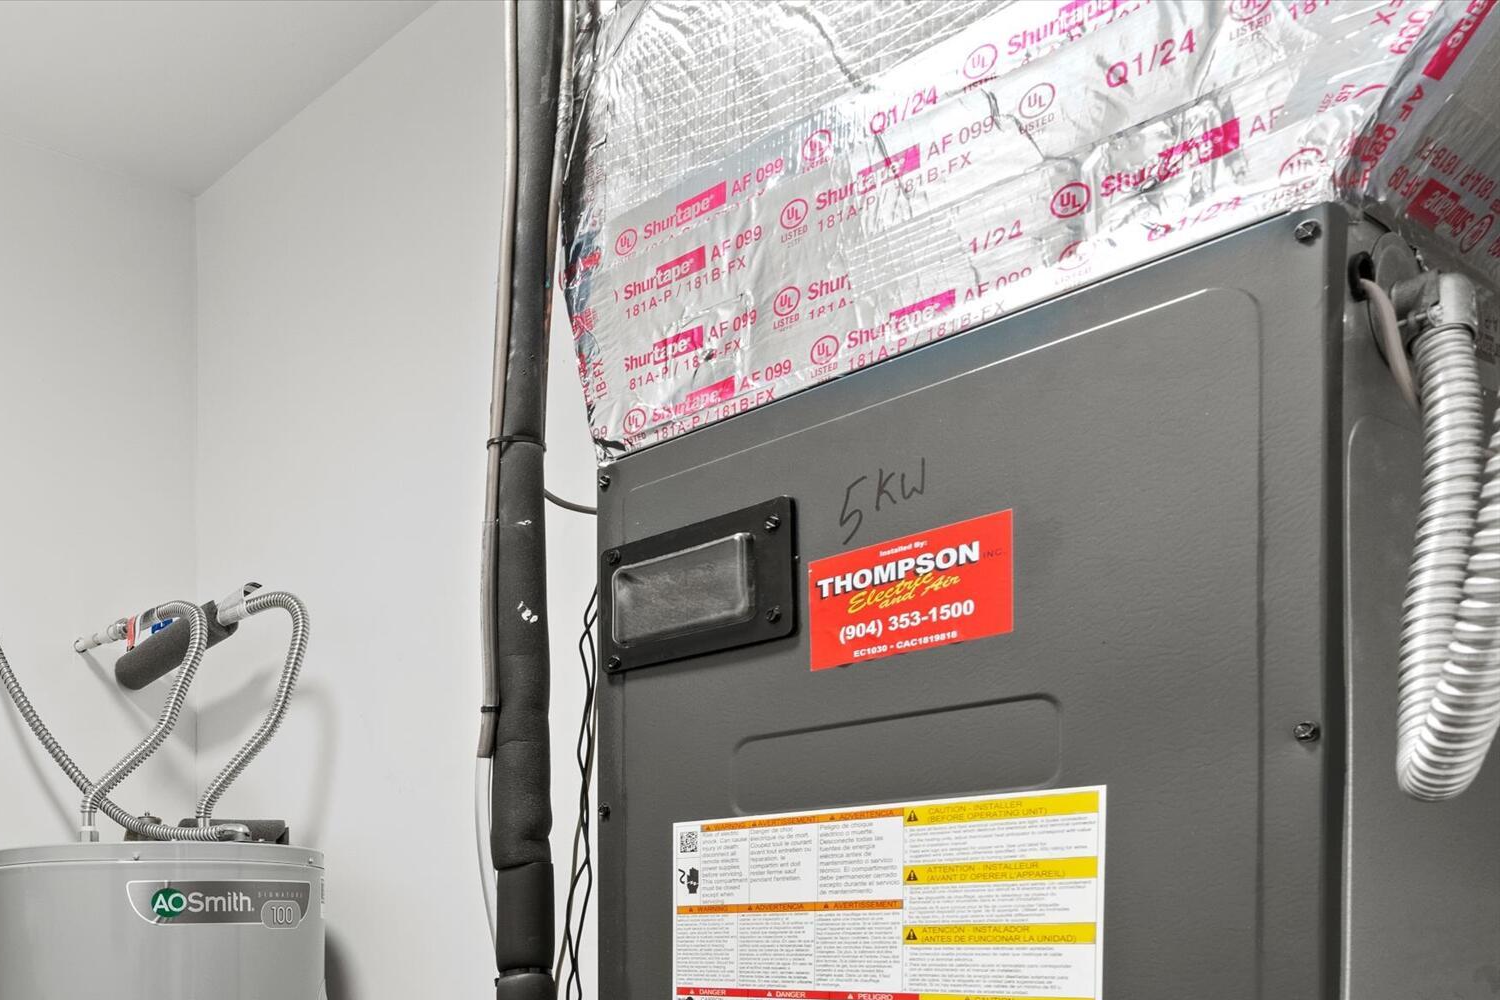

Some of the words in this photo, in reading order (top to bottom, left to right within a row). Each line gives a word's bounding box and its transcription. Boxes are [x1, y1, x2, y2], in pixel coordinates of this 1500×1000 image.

[1106, 29, 1197, 88] Q1/24
[869, 86, 938, 135] Q1/24
[1249, 105, 1285, 137] AF
[926, 134, 954, 161] AF
[959, 115, 995, 143] 099
[643, 192, 716, 240] Shurtape
[731, 171, 754, 196] AF
[756, 157, 784, 183] 099
[1059, 192, 1081, 211] UL
[780, 225, 808, 243] LISTED
[624, 258, 695, 301] Shurtape
[711, 238, 731, 262] AF
[735, 224, 763, 250] 099
[626, 289, 673, 319] 181A-P
[686, 256, 748, 295] 181B-FX
[732, 309, 758, 334] 099
[773, 313, 800, 330] LISTED
[849, 336, 909, 371] 181A-P
[764, 359, 793, 382] 099
[809, 361, 838, 379] LISTED
[839, 475, 868, 546] 5
[875, 457, 926, 512] KW
[878, 543, 912, 558] Installed
[914, 539, 928, 552] By:
[816, 540, 981, 599] THOMPSON
[846, 572, 934, 615] Electric
[879, 592, 916, 610] and
[922, 575, 961, 598] Air
[839, 618, 884, 645] (904)
[887, 598, 976, 632] 353-1500
[839, 810, 895, 822] ADVERTENCIA
[928, 805, 967, 815] CAUTION
[973, 801, 1023, 812] INSTALLER
[928, 812, 965, 823] (BEFORE
[967, 809, 1021, 820] OPERATING
[1021, 806, 1048, 816] UNIT)
[926, 865, 976, 875] ATTENTION
[982, 861, 1039, 872] INSTALLEUR
[926, 872, 960, 883] (AVANT
[969, 870, 1008, 881] OPERER
[270, 905, 294, 924] 100
[754, 903, 805, 912] ADVERTENCIA
[833, 900, 898, 910] AVERTISSEMENT
[920, 934, 951, 944] (ANTES
[952, 934, 966, 944] DE
[967, 934, 1021, 944] FUNCIONAR
[1022, 934, 1035, 944] LA
[1035, 933, 1077, 945] UNIDAD)
[971, 924, 1030, 935] INSTALADOR
[699, 987, 727, 997] DANGER
[775, 990, 807, 999] DANGER
